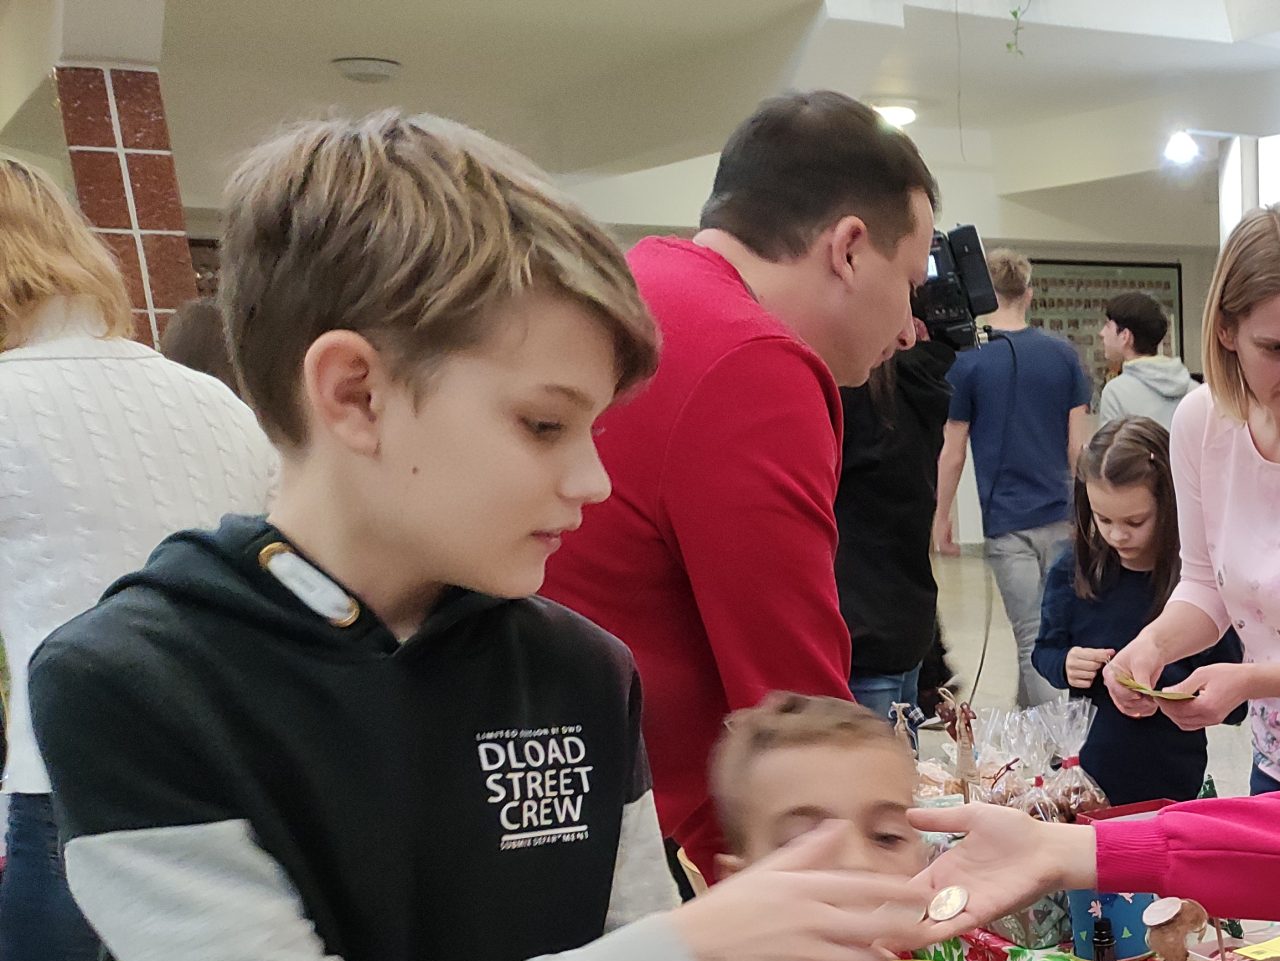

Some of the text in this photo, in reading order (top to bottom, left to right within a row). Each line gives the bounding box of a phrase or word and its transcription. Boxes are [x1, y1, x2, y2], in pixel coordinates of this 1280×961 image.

[478, 736, 586, 771] DLOAD
[486, 766, 594, 803] STREET
[500, 795, 583, 830] CREW
